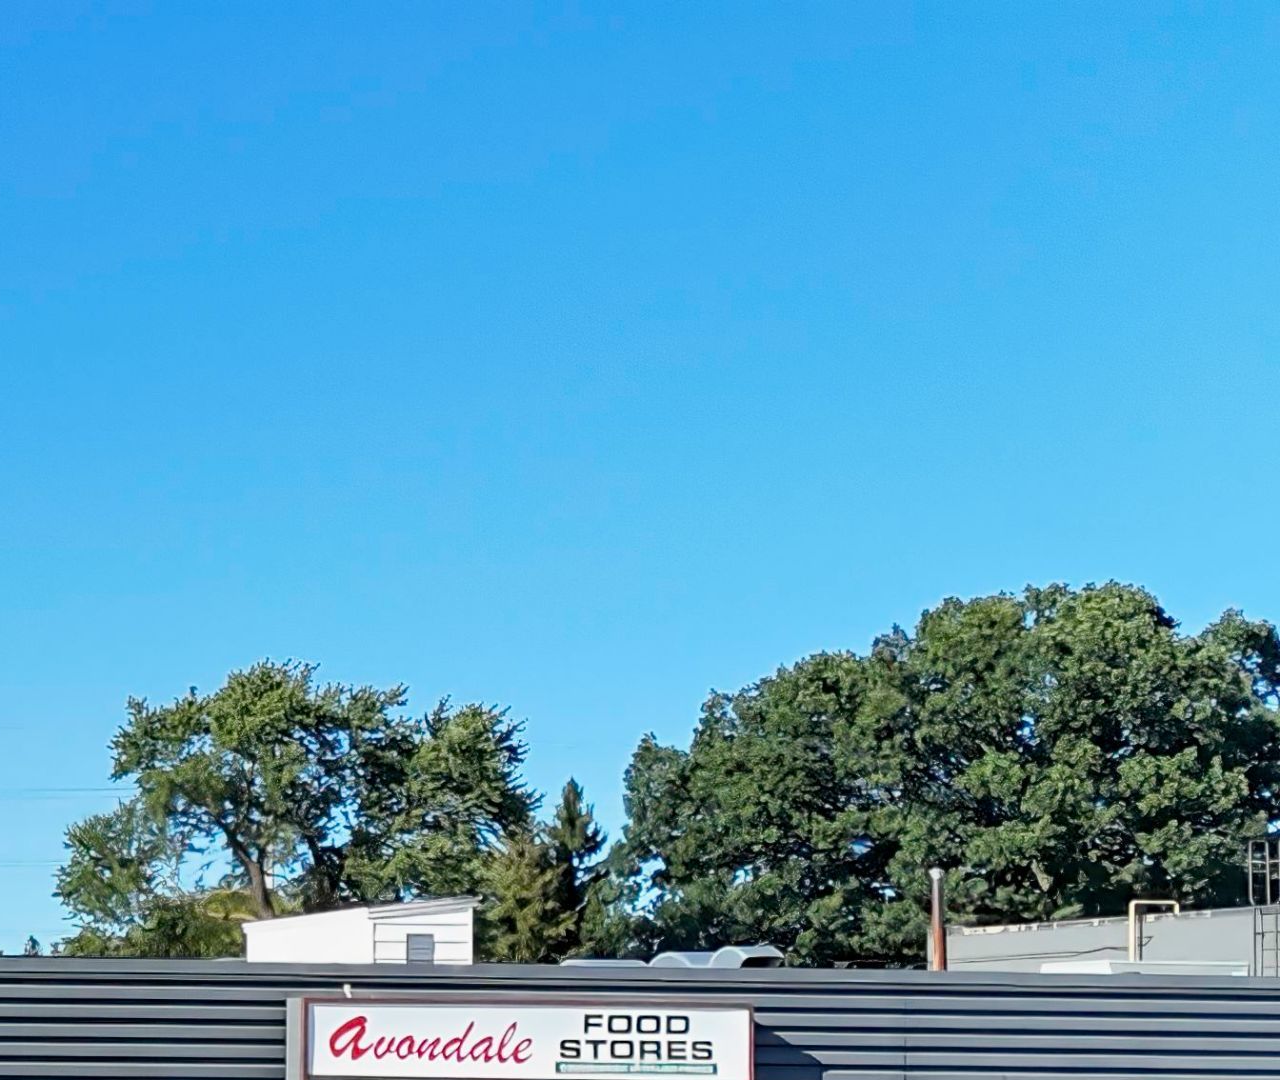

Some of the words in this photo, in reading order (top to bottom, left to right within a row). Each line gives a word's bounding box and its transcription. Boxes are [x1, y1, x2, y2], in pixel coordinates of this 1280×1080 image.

[584, 1014, 690, 1034] FOOD
[329, 1015, 533, 1065] Avondale
[559, 1039, 713, 1060] STORES
